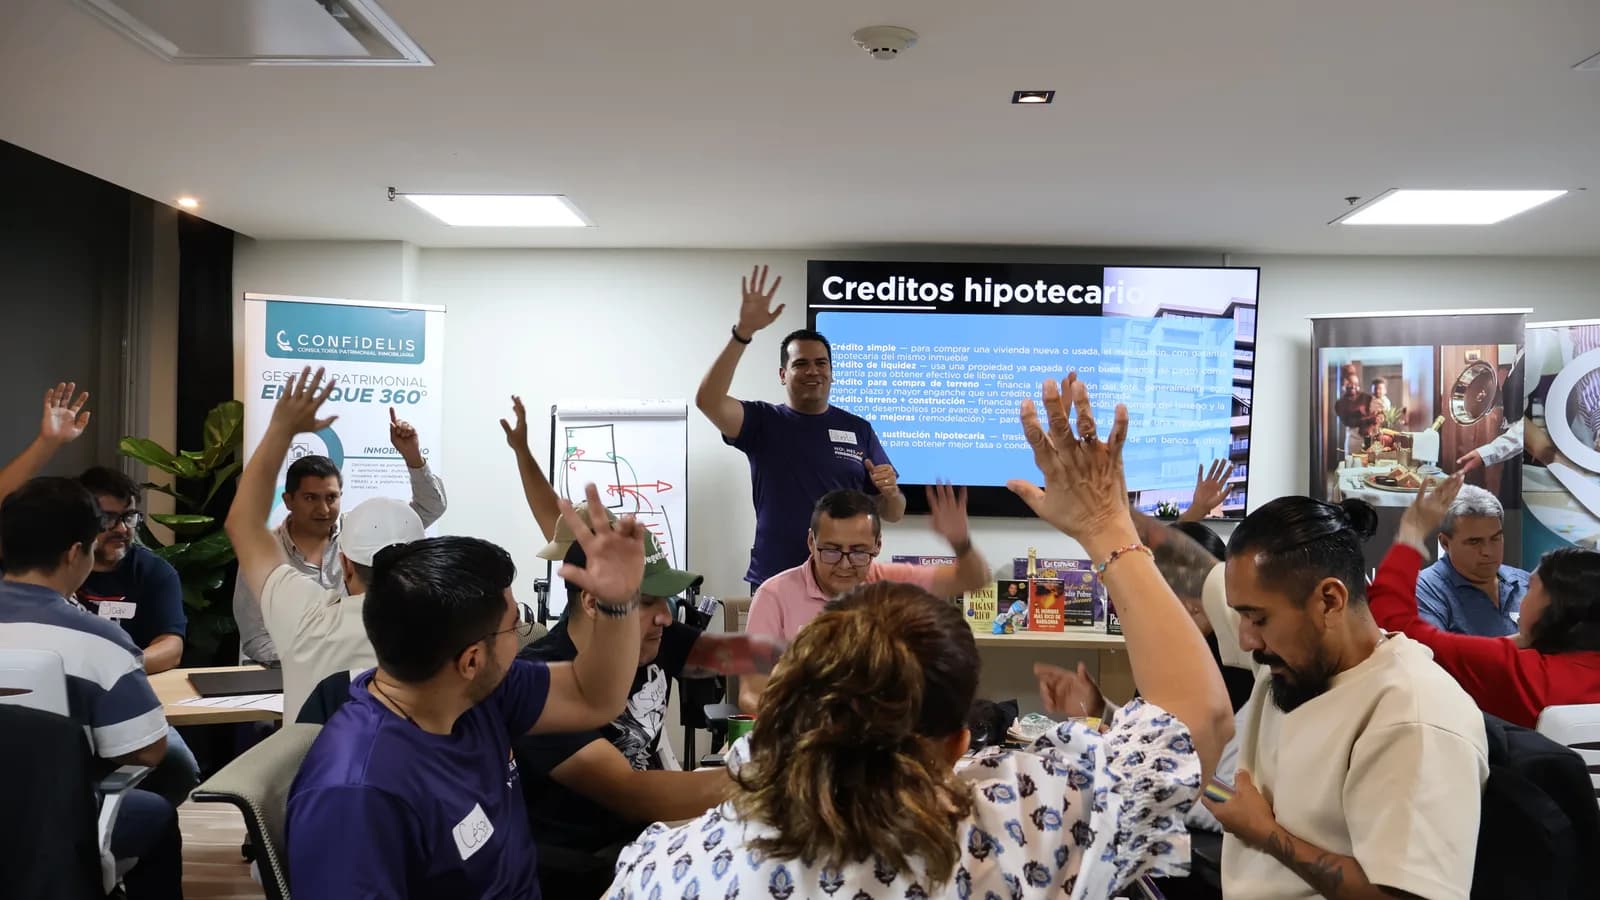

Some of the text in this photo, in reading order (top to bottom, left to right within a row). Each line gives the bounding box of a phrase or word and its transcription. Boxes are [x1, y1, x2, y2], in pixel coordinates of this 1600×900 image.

[822, 276, 955, 302] Creditos
[830, 342, 864, 351] Crédito
[867, 343, 896, 353] simple
[911, 345, 930, 353] para
[934, 346, 970, 354] comprar
[993, 346, 1030, 354] vivienda
[1072, 346, 1100, 356] usada,
[831, 360, 864, 368] Crédito
[866, 361, 878, 369] de
[881, 361, 916, 370] liquidez
[968, 364, 1014, 372] propiedad
[1016, 364, 1027, 372] ya
[1030, 364, 1062, 373] pagada
[332, 372, 426, 388] PATRIMONIAL
[868, 372, 888, 380] para
[926, 371, 960, 379] efectivo
[976, 372, 996, 380] libre
[868, 380, 888, 388] para
[860, 388, 884, 396] plazo
[924, 388, 966, 398] enganche
[1000, 390, 1031, 398] crédito
[830, 395, 862, 403] Crédito
[908, 396, 966, 404] construcción
[872, 404, 928, 413] desembolsos
[880, 414, 915, 422] mejoras
[918, 414, 985, 424] (remodelación)
[882, 430, 930, 440] sustitución
[934, 432, 985, 441] hipotecaria
[890, 440, 910, 448] para
[948, 441, 973, 450] mejor
